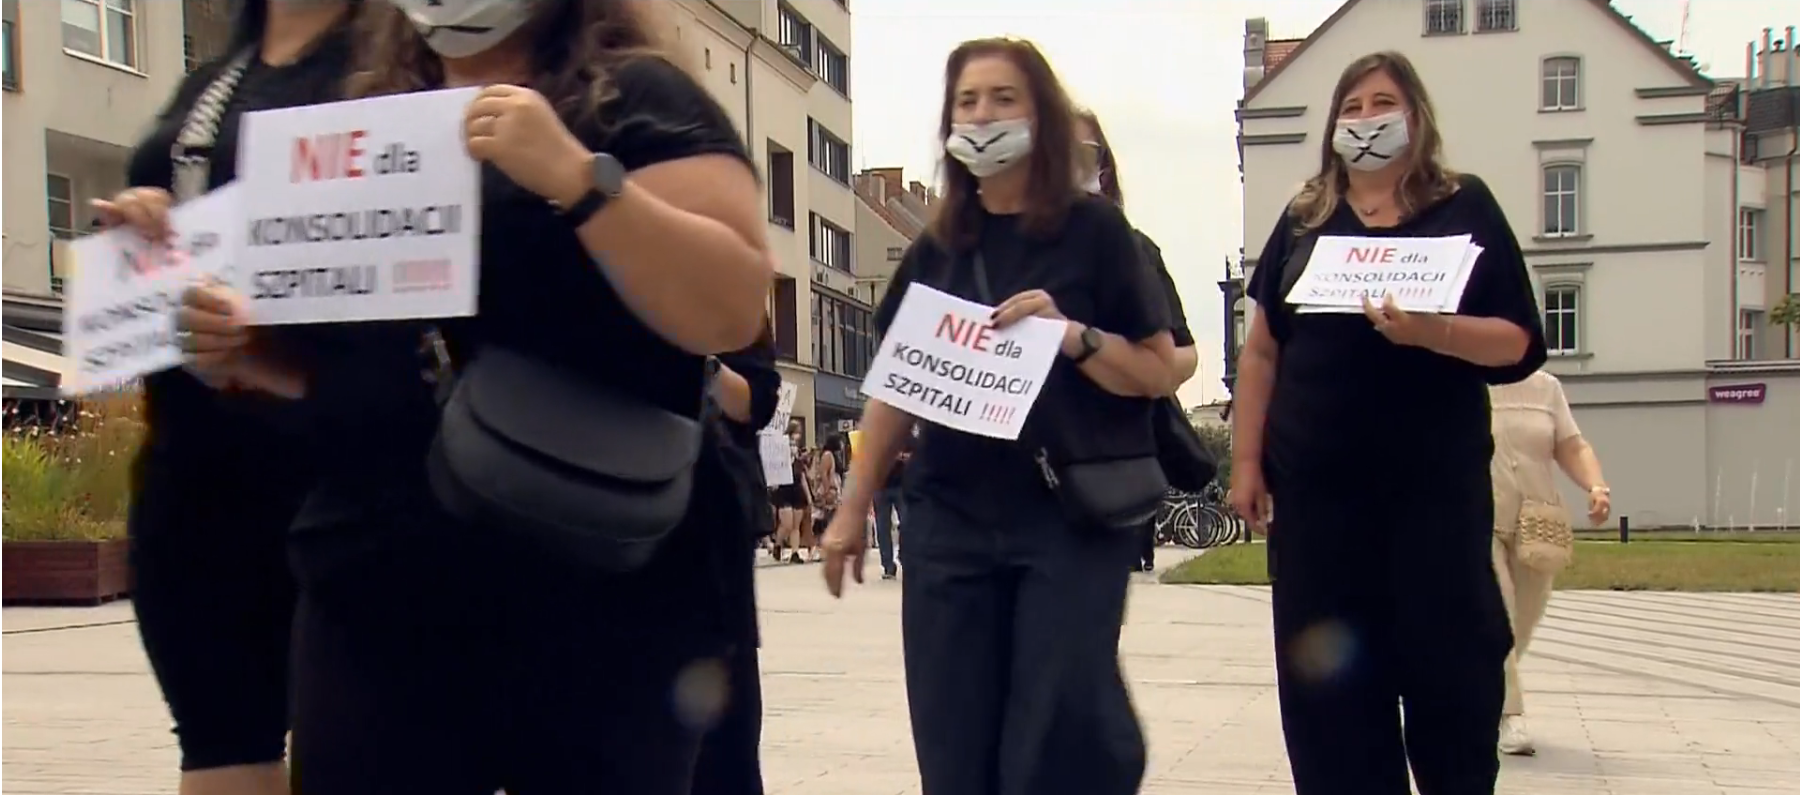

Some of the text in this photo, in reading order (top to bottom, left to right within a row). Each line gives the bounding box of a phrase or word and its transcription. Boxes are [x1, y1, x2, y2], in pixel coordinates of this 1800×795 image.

[292, 129, 420, 184] NIE dla
[1346, 247, 1428, 264] NIE dla
[935, 312, 1022, 359] NIE dla
[892, 342, 1033, 396] KONSOLIDACJI
[884, 373, 973, 416] SZPITALI
[1715, 389, 1761, 400] weagree
